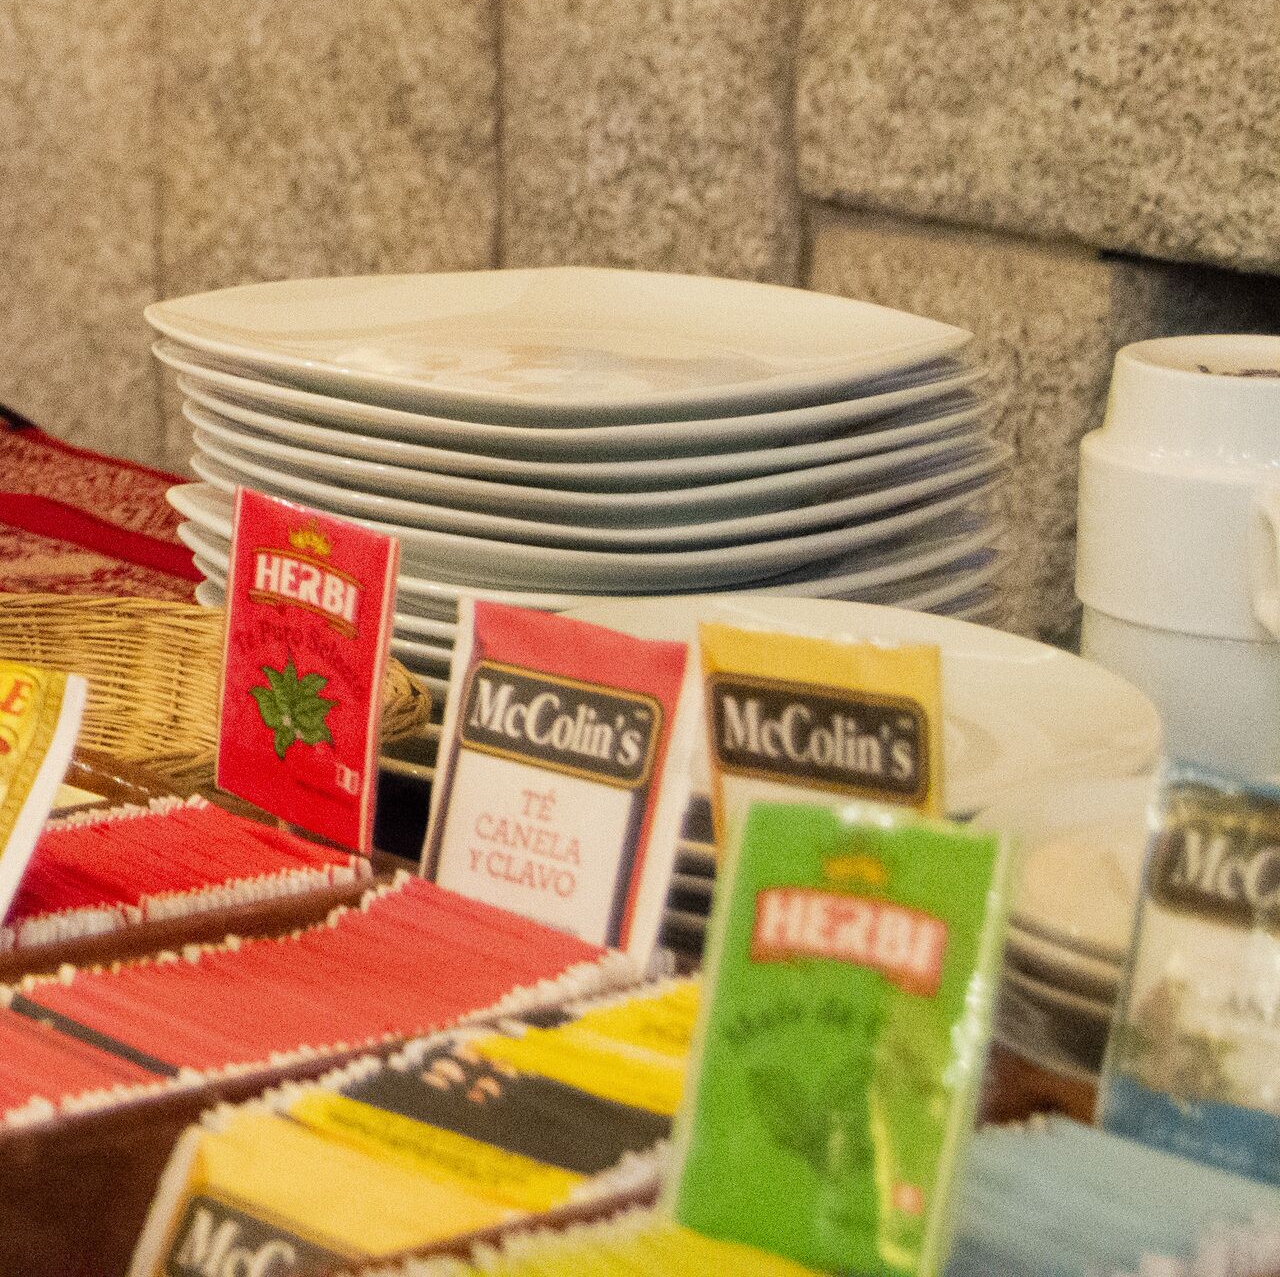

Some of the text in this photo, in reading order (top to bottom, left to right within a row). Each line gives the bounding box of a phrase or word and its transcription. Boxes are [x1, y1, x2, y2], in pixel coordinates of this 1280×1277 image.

[253, 552, 361, 624] HERBI
[470, 677, 643, 766] McColin's
[721, 696, 915, 777] McColin's
[520, 786, 557, 818] TÉ
[467, 846, 578, 899] Y CLAVO
[473, 814, 583, 867] CANELA
[756, 888, 946, 982] HERBI
